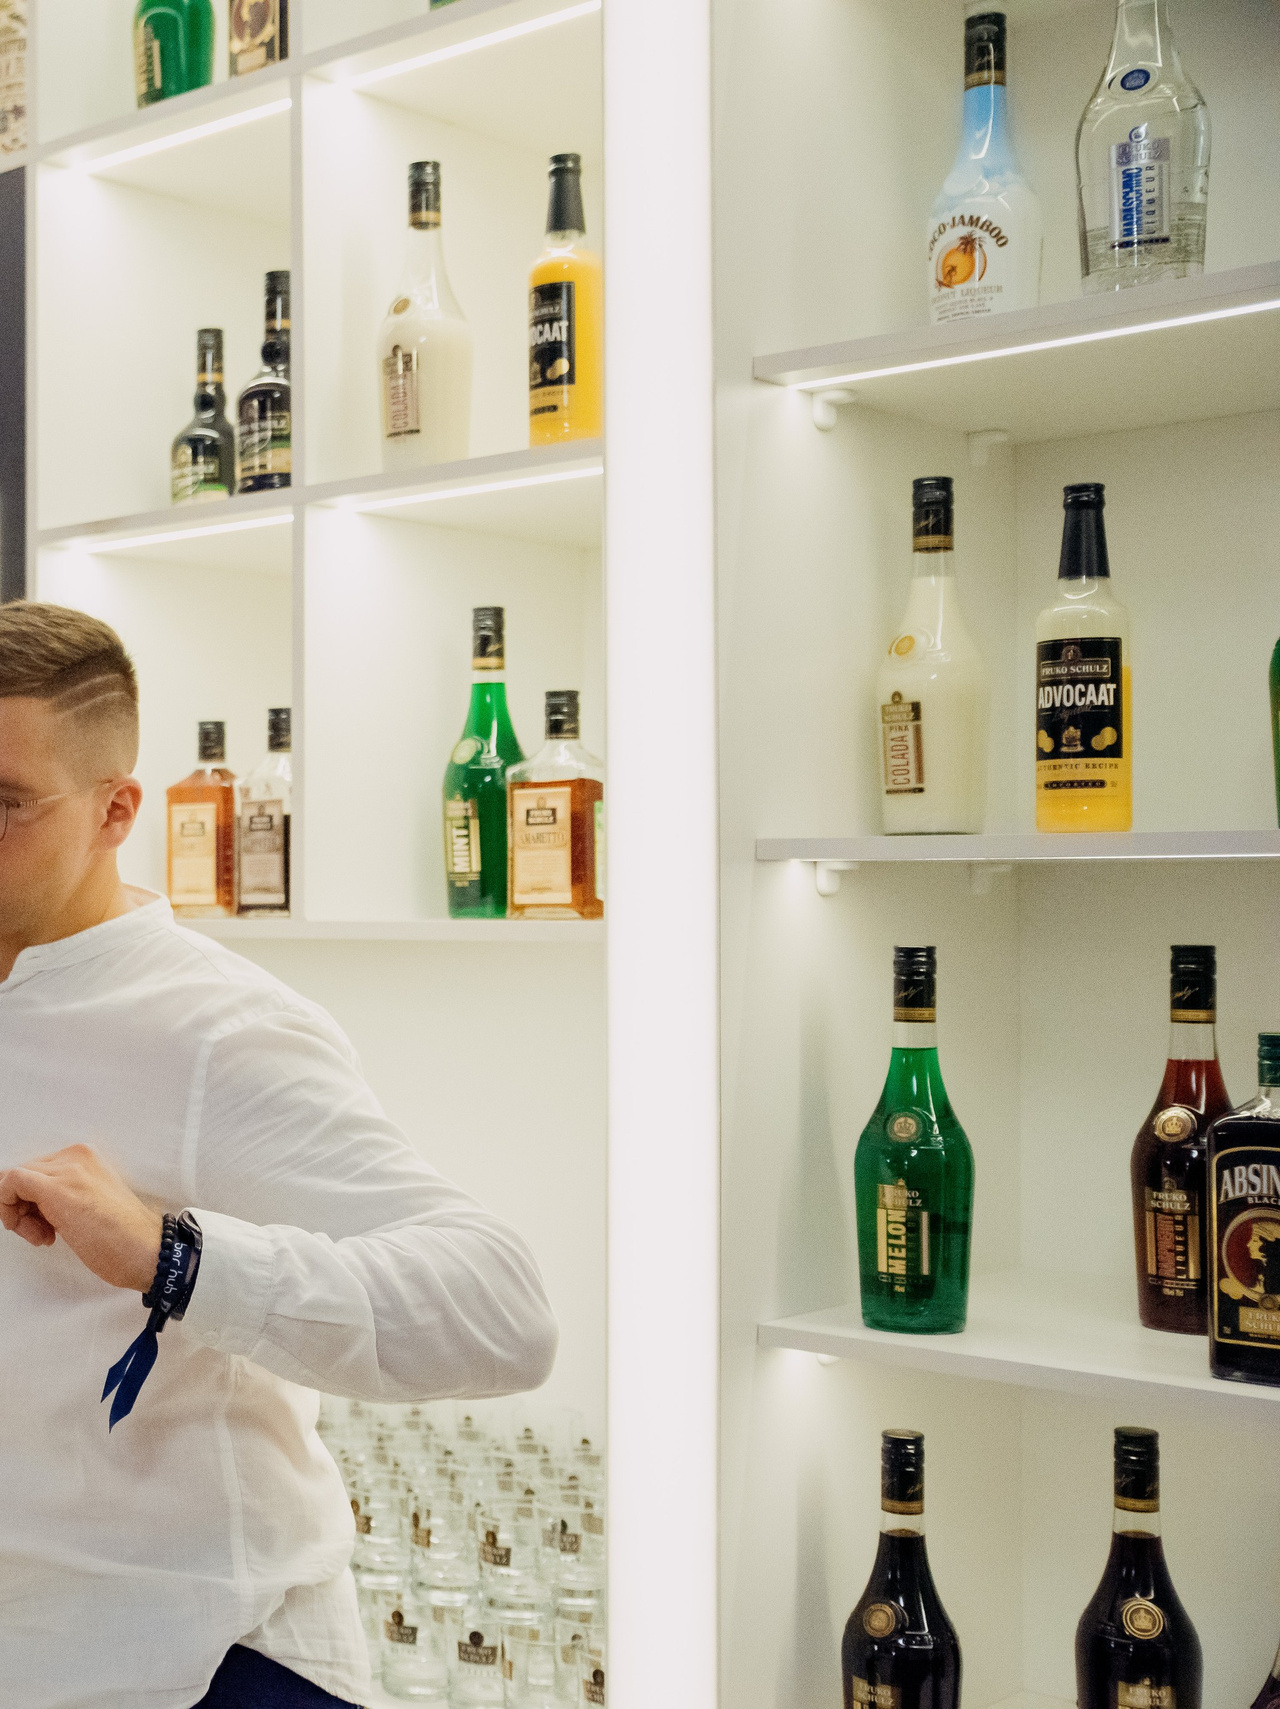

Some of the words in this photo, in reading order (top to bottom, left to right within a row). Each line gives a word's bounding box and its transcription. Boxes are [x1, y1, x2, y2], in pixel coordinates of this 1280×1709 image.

[1145, 164, 1156, 235] LIQUEUR
[1070, 664, 1109, 673] SCHULZ
[1038, 683, 1117, 710] ADVOCAAT
[890, 735, 911, 786] COLADA
[452, 827, 470, 873] MINT
[1150, 1199, 1191, 1211] SCHULZ
[1152, 1191, 1187, 1202] FRUKO
[1247, 1196, 1280, 1206] BLAC
[887, 1209, 906, 1275] MELON
[1174, 1214, 1187, 1280] LIQUEUR
